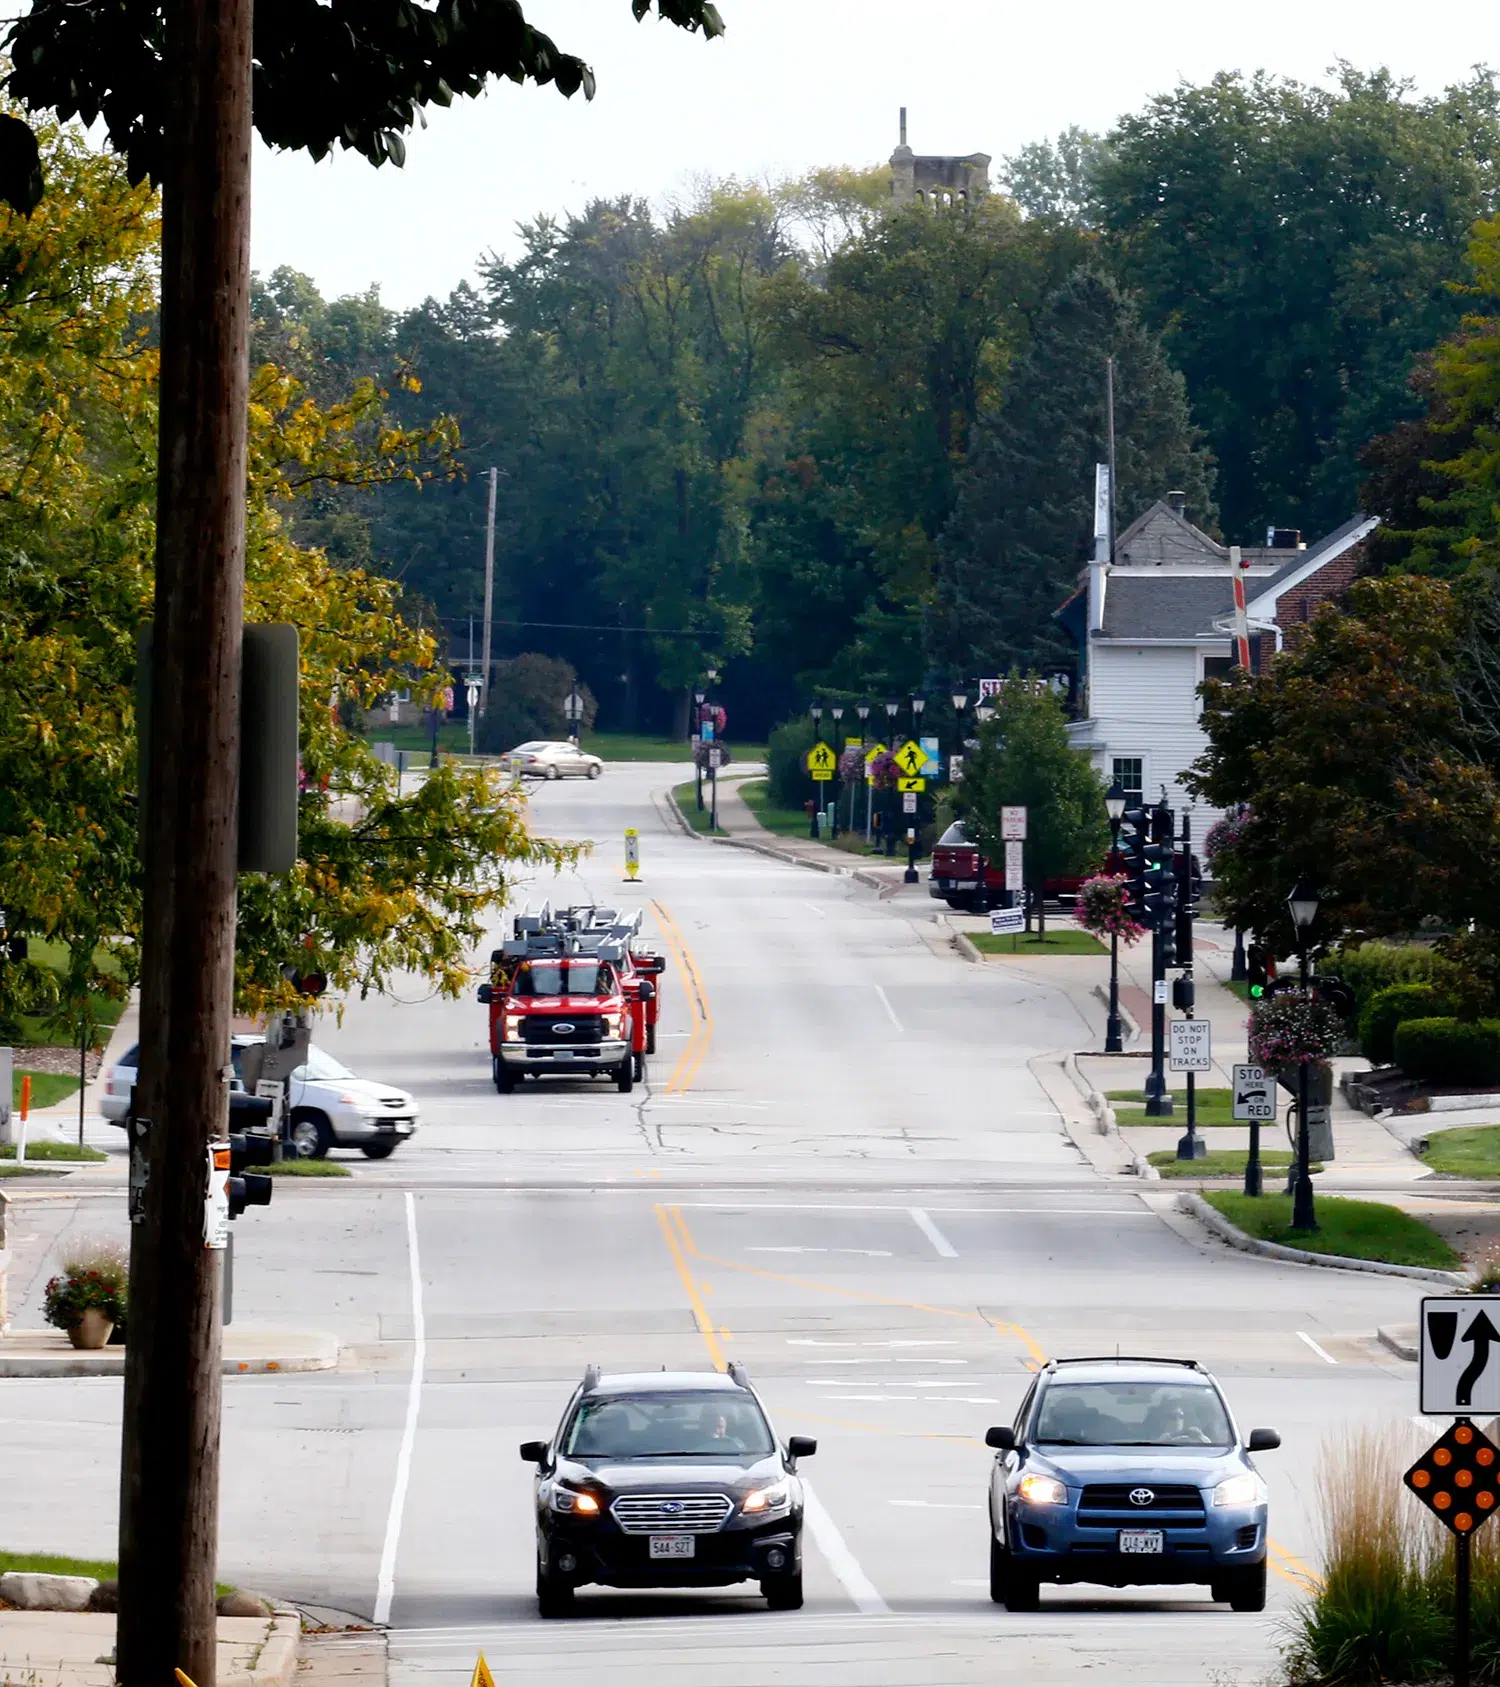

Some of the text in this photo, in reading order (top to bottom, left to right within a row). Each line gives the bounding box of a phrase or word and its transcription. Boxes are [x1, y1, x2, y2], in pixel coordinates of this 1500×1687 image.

[1173, 1025, 1207, 1033] DO NOT
[1178, 1036, 1202, 1044] STOP
[1183, 1047, 1197, 1055] ON
[1172, 1058, 1208, 1066] TRACKS
[1239, 1069, 1265, 1080] STO
[1248, 1105, 1271, 1116] RED
